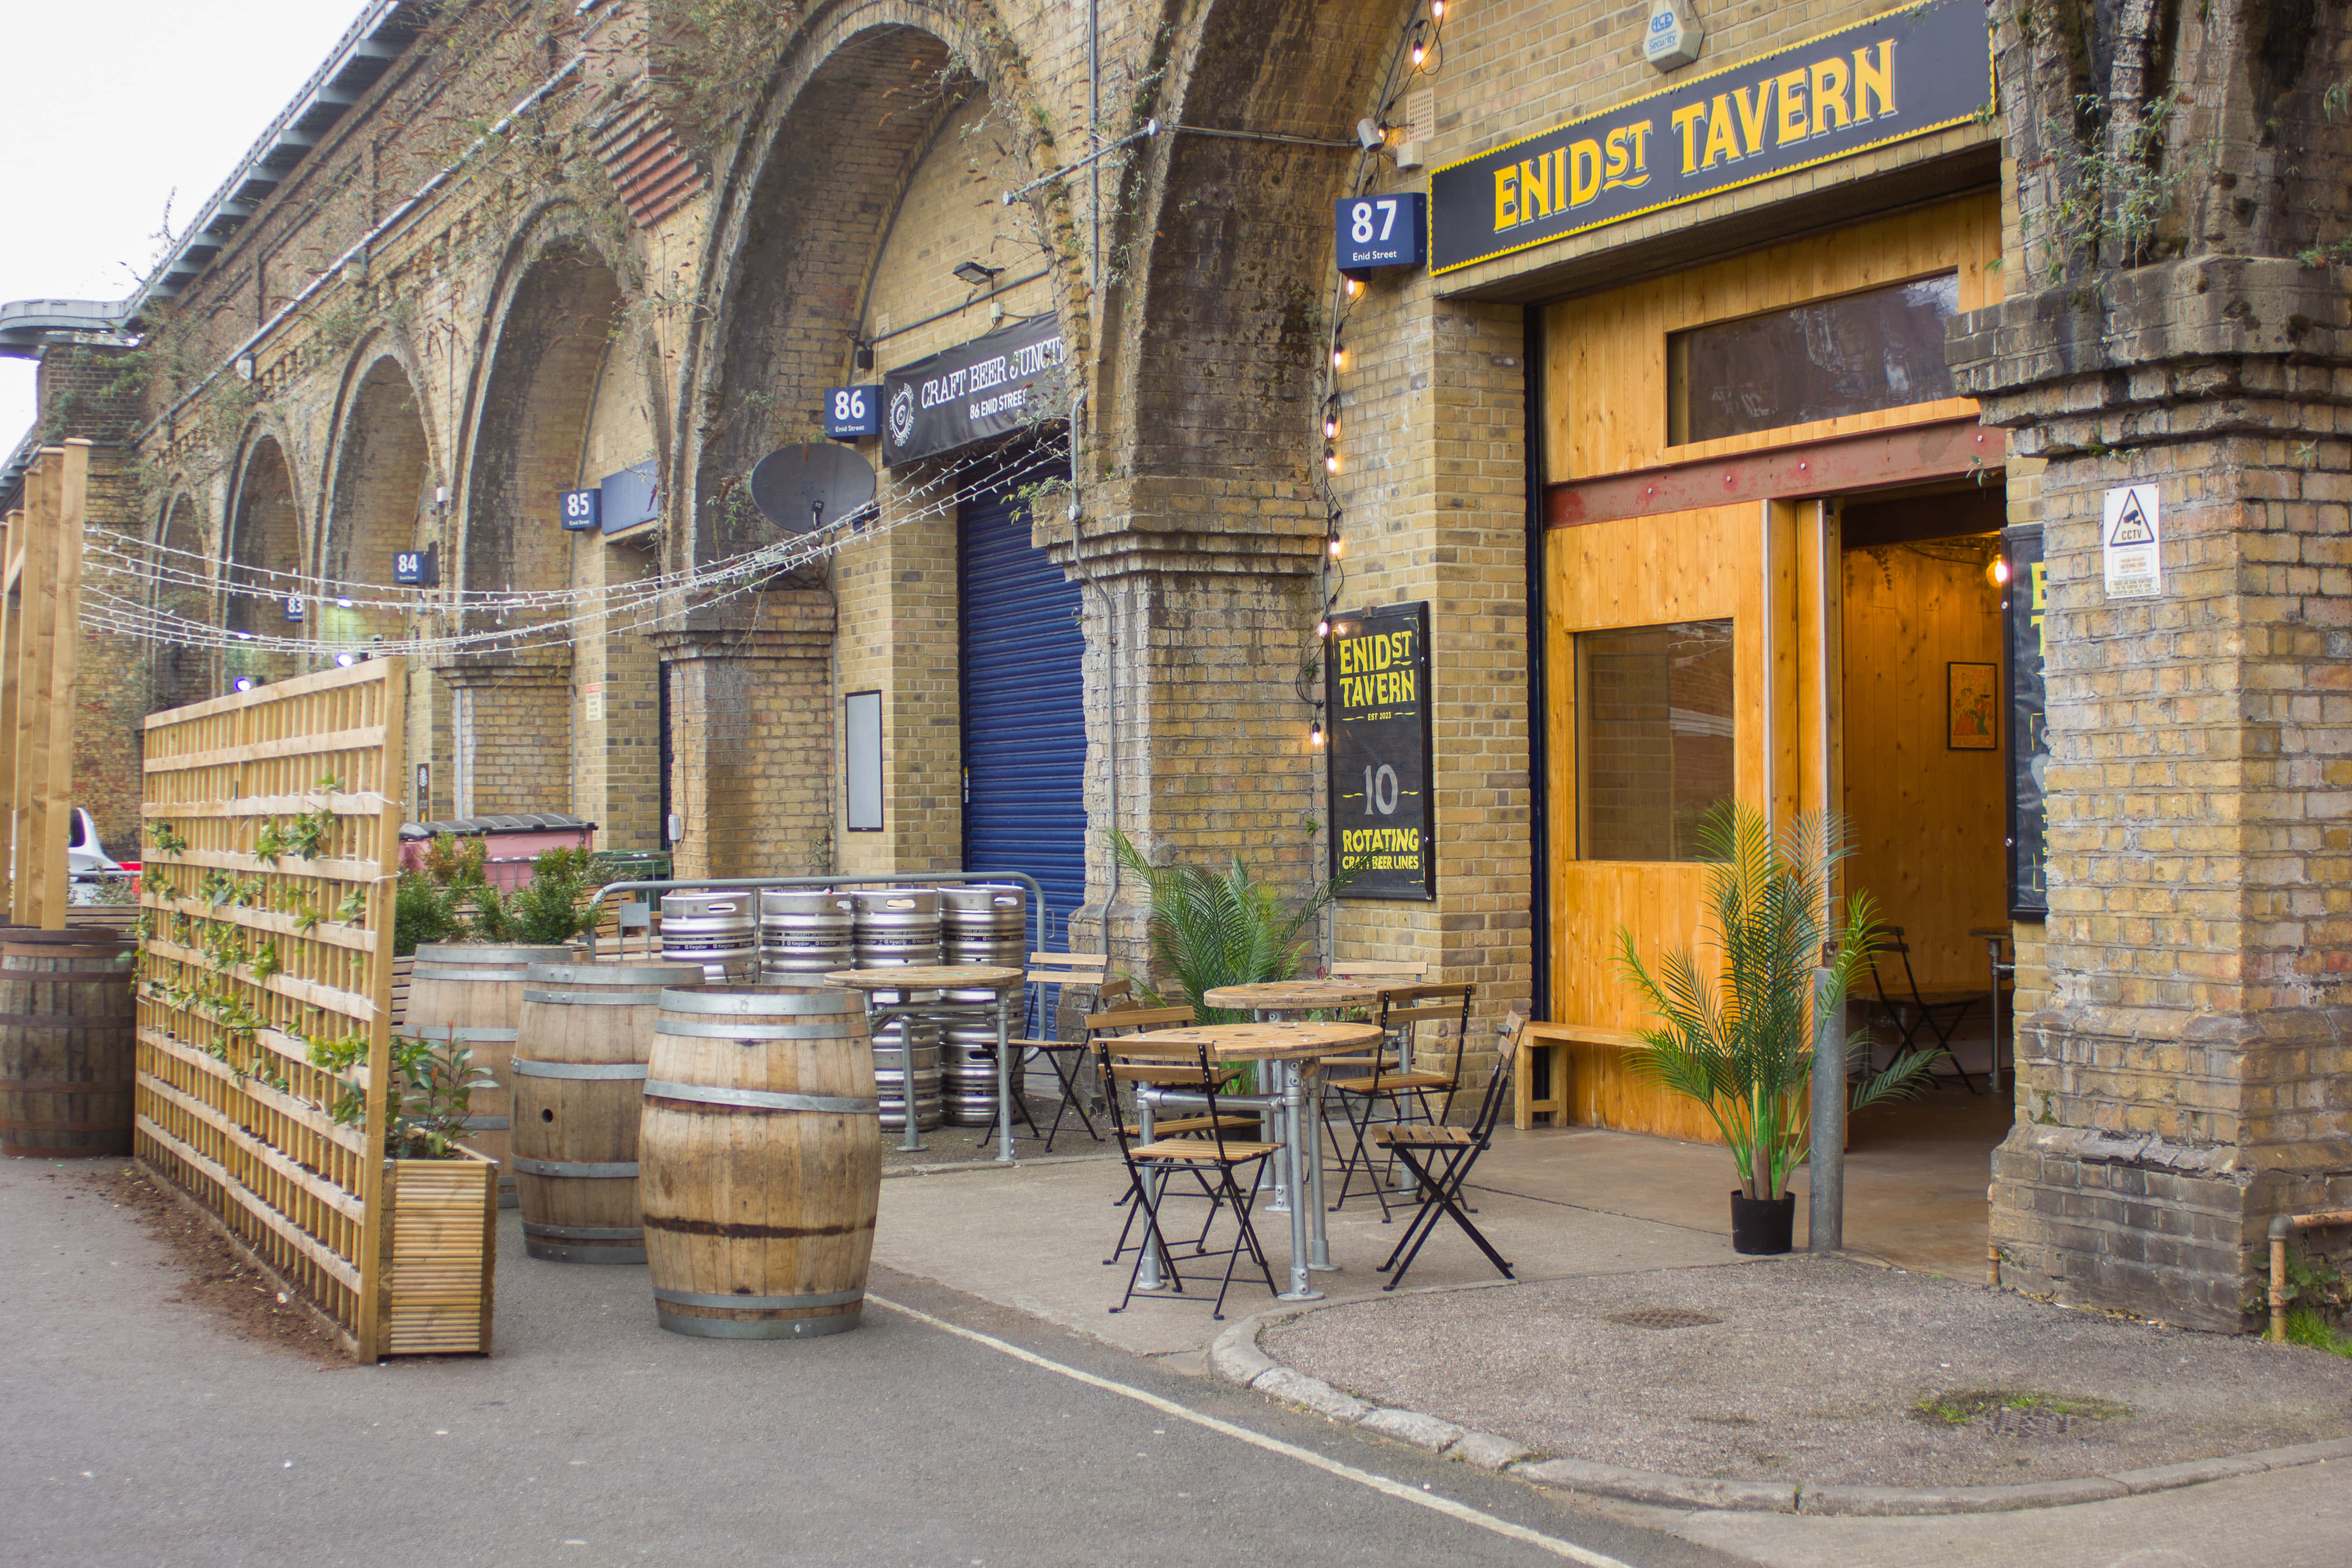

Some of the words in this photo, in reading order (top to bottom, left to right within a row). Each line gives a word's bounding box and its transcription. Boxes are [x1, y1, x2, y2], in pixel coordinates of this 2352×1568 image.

[1652, 12, 1674, 32] ACE
[1649, 34, 1677, 50] Security
[1671, 38, 1898, 177] TAVERN
[1351, 200, 1397, 243] 87
[1352, 251, 1371, 262] Enid
[1372, 250, 1397, 260] Street
[921, 369, 966, 409] CRAFT
[969, 355, 1007, 393] BEER
[1009, 336, 1063, 380] JUNCTI
[835, 389, 865, 420] 86
[970, 403, 980, 420] 86
[981, 397, 998, 417] ENID
[999, 388, 1027, 412] STREET
[568, 492, 590, 517] 85
[2122, 529, 2142, 540] CCTV
[398, 554, 419, 573] 84
[288, 597, 303, 613] 83
[1339, 669, 1415, 708] TAVERN
[1368, 713, 1378, 721] EST
[1363, 764, 1399, 815] 10
[1343, 828, 1419, 852] ROTATING
[1372, 856, 1393, 870] BEER
[1393, 855, 1419, 870] LINES
